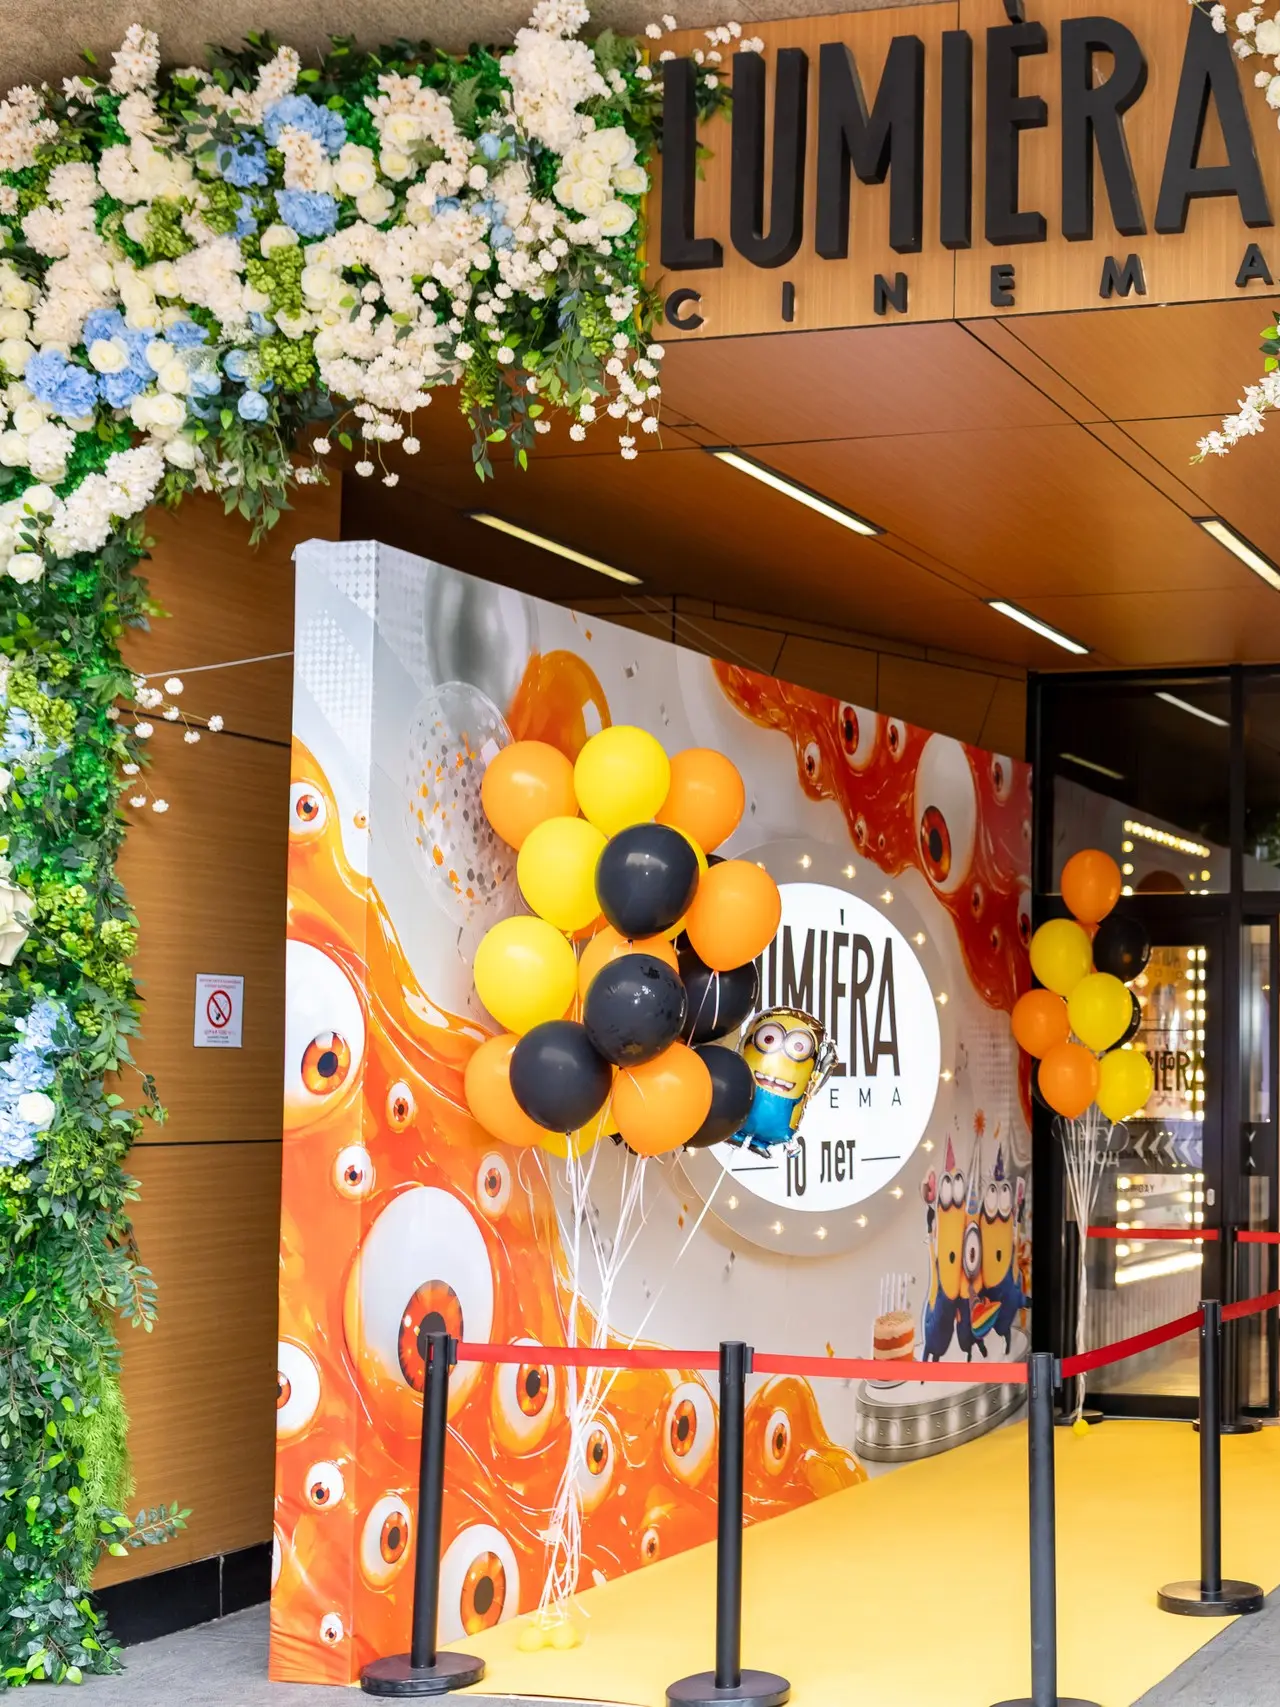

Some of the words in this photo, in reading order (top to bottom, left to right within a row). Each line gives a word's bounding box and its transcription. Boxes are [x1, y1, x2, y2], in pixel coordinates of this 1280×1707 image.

[660, 0, 1275, 271] LUMIÈRA
[664, 243, 1275, 331] CINEMA
[829, 1088, 903, 1109] EMA
[784, 1136, 807, 1197] 10
[819, 1139, 857, 1184] лет
